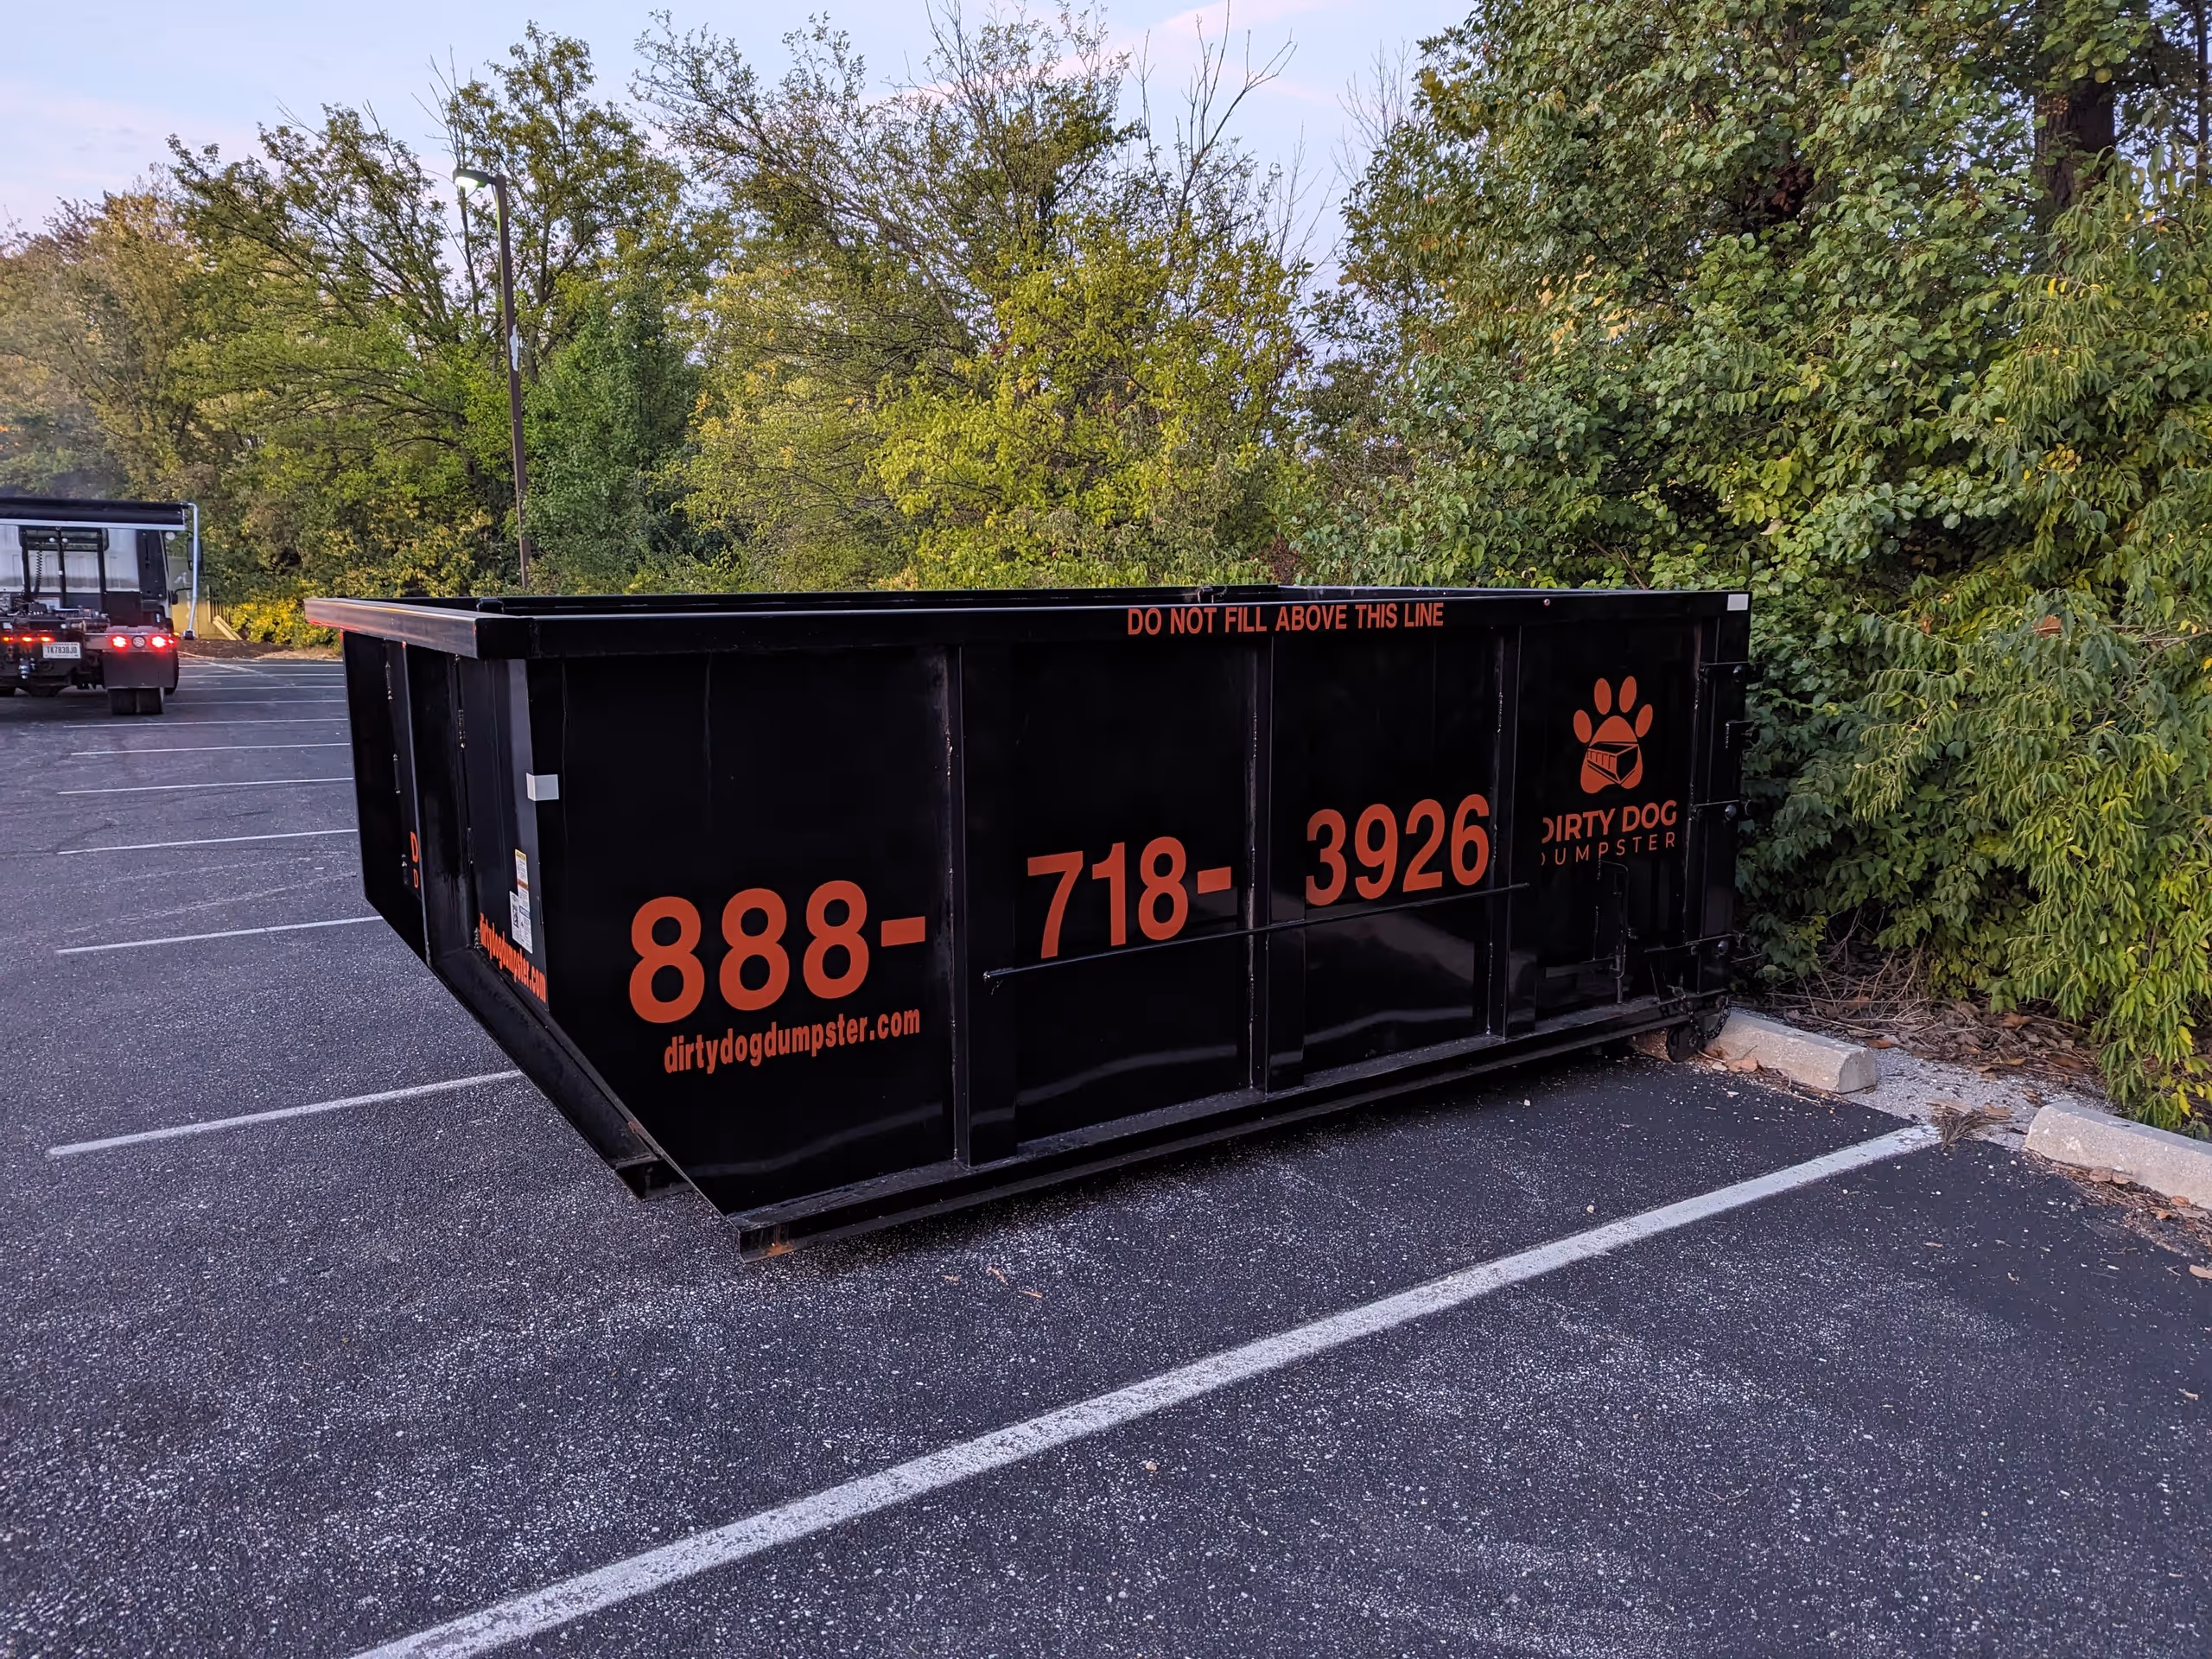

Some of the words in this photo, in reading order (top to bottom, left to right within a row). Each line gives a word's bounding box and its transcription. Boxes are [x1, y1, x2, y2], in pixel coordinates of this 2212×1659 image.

[1128, 607, 1162, 635] DO
[1170, 607, 1217, 634] NOT
[1224, 606, 1268, 632] FILL
[1275, 603, 1347, 632] ABOVE
[1355, 603, 1397, 628] THIS
[1404, 602, 1444, 627] LINE
[1622, 799, 1677, 833] DOG
[629, 880, 925, 1024] 888-
[1027, 836, 1231, 959] 718-
[1306, 794, 1490, 906] 3926
[664, 1008, 920, 1074] dirtydogdumpster.com
